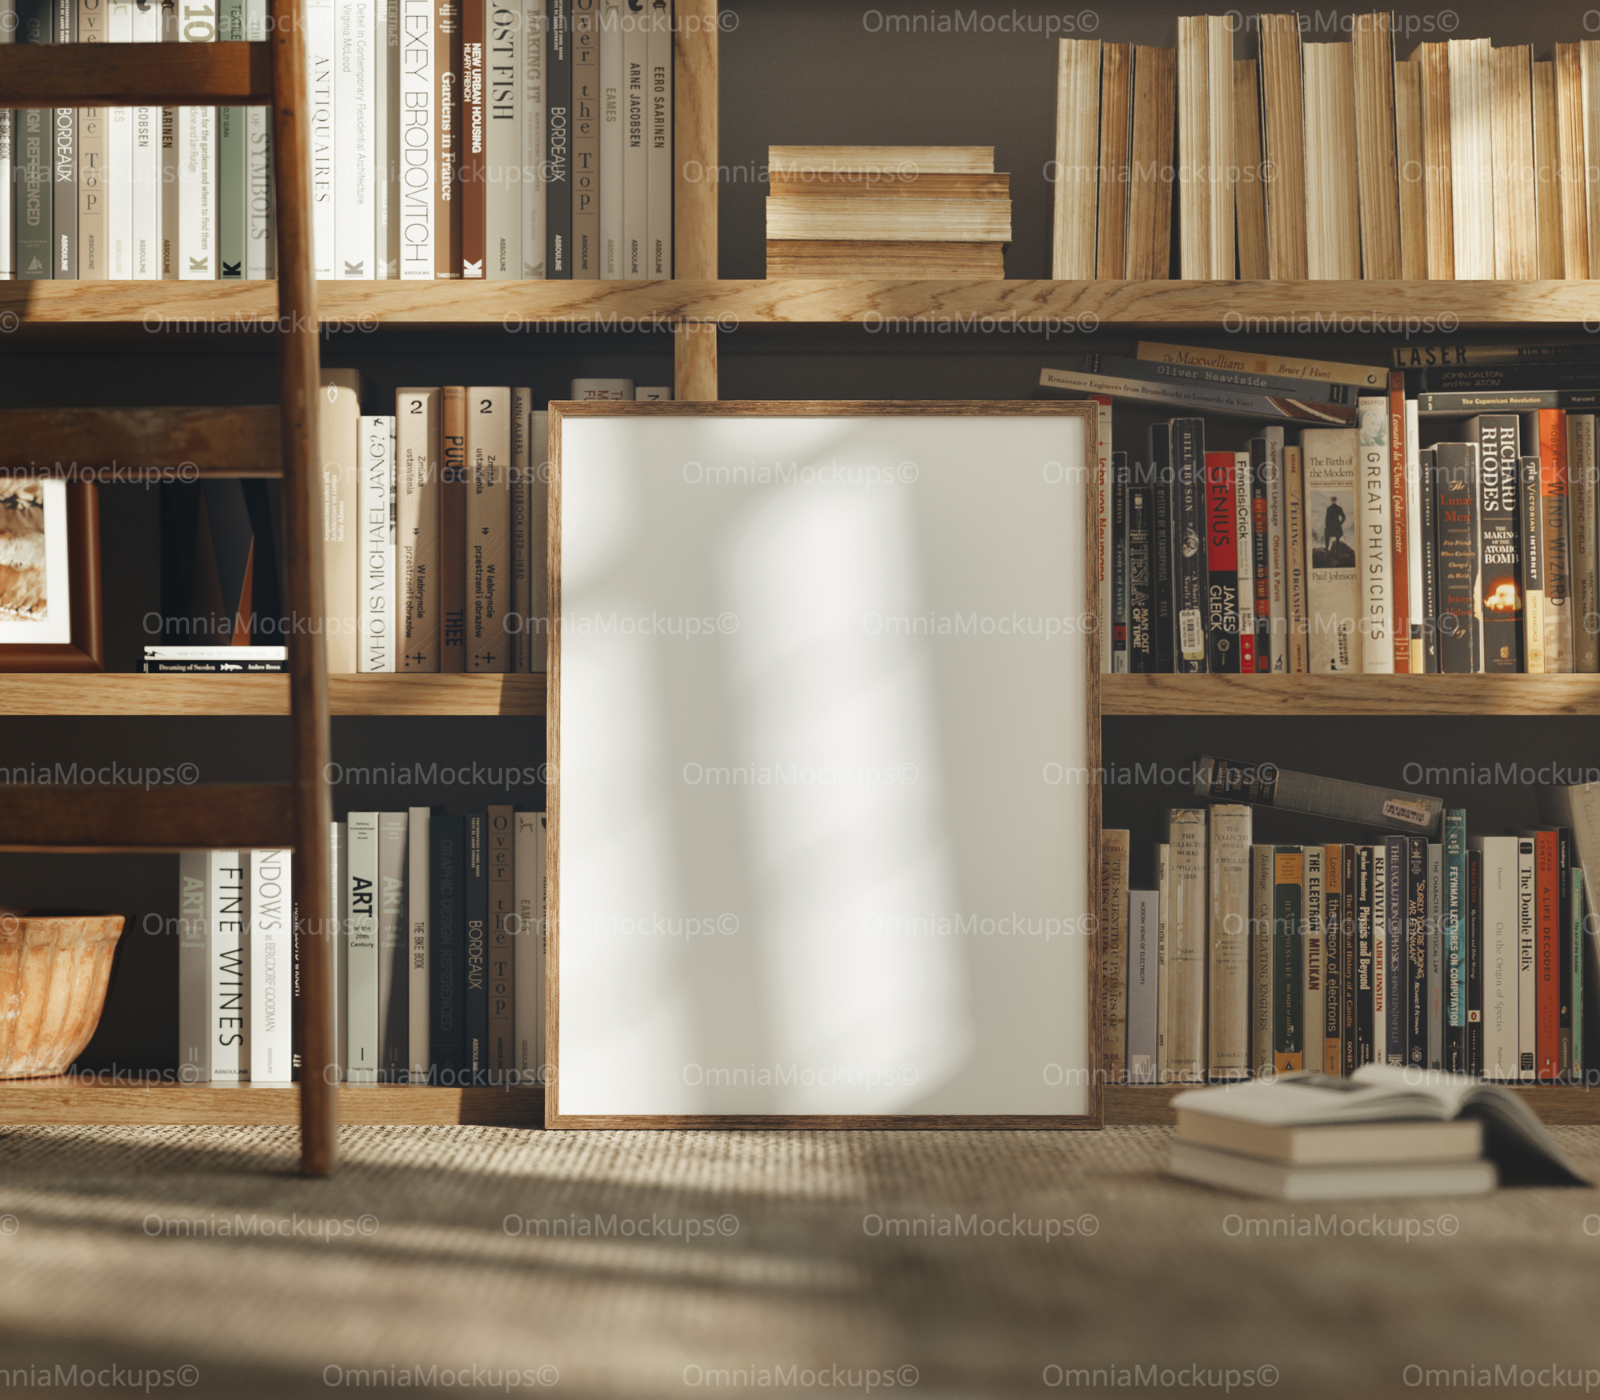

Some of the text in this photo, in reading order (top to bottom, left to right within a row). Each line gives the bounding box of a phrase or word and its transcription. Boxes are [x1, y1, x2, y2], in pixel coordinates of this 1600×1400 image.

[341, 3, 352, 73] Virginia McLeod
[526, 9, 541, 80] MAKING
[354, 3, 366, 205] Detail Contemporary Residential Architecture
[472, 43, 481, 153] NEW URBAN HOUSING
[492, 65, 514, 120] FISH
[606, 87, 617, 122] EAMES
[630, 62, 640, 147] ARNE JACOBSEN
[654, 66, 665, 148] EERO SAARINEN
[57, 107, 73, 182] BORDEAUX
[312, 54, 330, 203] ANTIQUAIRES
[441, 71, 456, 201] Gardens in France
[551, 107, 566, 182] BORDEAUX
[27, 136, 40, 226] REFERENCED
[200, 143, 210, 250] gardens and where them
[251, 132, 271, 241] SYMBOLS
[404, 92, 429, 261] BRODOVITCH
[61, 234, 69, 272] ASSOULINE
[163, 238, 171, 274] ASSOULINE
[1047, 374, 1182, 399] Renaissance Engineers Brunelleschi
[1157, 365, 1267, 387] Oliver Heaviside
[1176, 351, 1331, 379] Maxwellians Bruce Hunt
[1396, 347, 1467, 366] LASER
[1475, 379, 1501, 387] ATOM
[410, 400, 423, 414] 2
[480, 399, 493, 414] 2
[1474, 396, 1541, 406] Copernican Revolution
[406, 448, 415, 495] ustawienia
[476, 447, 485, 494] ustawienia
[515, 396, 525, 527] ANNI ALBERS NOTEBOOK
[1184, 464, 1193, 512] BRYSON
[1324, 468, 1354, 478] Modern
[1325, 457, 1345, 466] Birth
[1481, 426, 1499, 512] RHODES
[1500, 426, 1516, 511] RICHARD
[1212, 466, 1230, 547] GENIUS
[1270, 492, 1279, 527] Language
[1440, 494, 1473, 506] Lunar
[1444, 511, 1471, 522] Men
[1526, 483, 1538, 580] VICTORIAN INTERNET
[369, 434, 385, 671] JANG? MICHAEL IS WHO
[1312, 571, 1357, 582] Paul Johnson
[1367, 451, 1385, 640] GREAT PHYSICISTS
[1484, 554, 1519, 565] BOMB
[1547, 481, 1566, 607] WIND WIZARD
[415, 576, 426, 619] labiryncie
[484, 576, 496, 619] labiryncie
[1141, 608, 1149, 654] MAN OUT
[1210, 585, 1222, 631] GLEICK
[1223, 585, 1236, 632] JAMES
[1133, 624, 1141, 649] TIME
[183, 875, 204, 918] ART
[352, 876, 372, 918] ART
[1308, 853, 1320, 991] THE ELECTRON MILLIKAN
[1375, 857, 1384, 930] RELATIVITY
[1391, 865, 1400, 918] EVOLUTION
[1521, 866, 1533, 972] The Double Helix
[219, 868, 243, 1046] FINE WINES
[350, 942, 375, 950] Century
[468, 920, 483, 990] BORDEAUX
[1109, 887, 1120, 1011] SCIENTIFIC PAPERS
[1260, 854, 1269, 1031] Babbage CALCULATING ENGINES
[1326, 856, 1340, 1032] Lorentz the theory electrons
[1358, 906, 1371, 990] Physics and Beyond
[1450, 866, 1459, 1027] FEYNMAN LECTURES ON COMPUTATION
[1543, 897, 1551, 981] LIFE DECODED
[264, 942, 276, 1032] BERGDORF GOODMAN
[1495, 957, 1504, 1032] Origin Species
